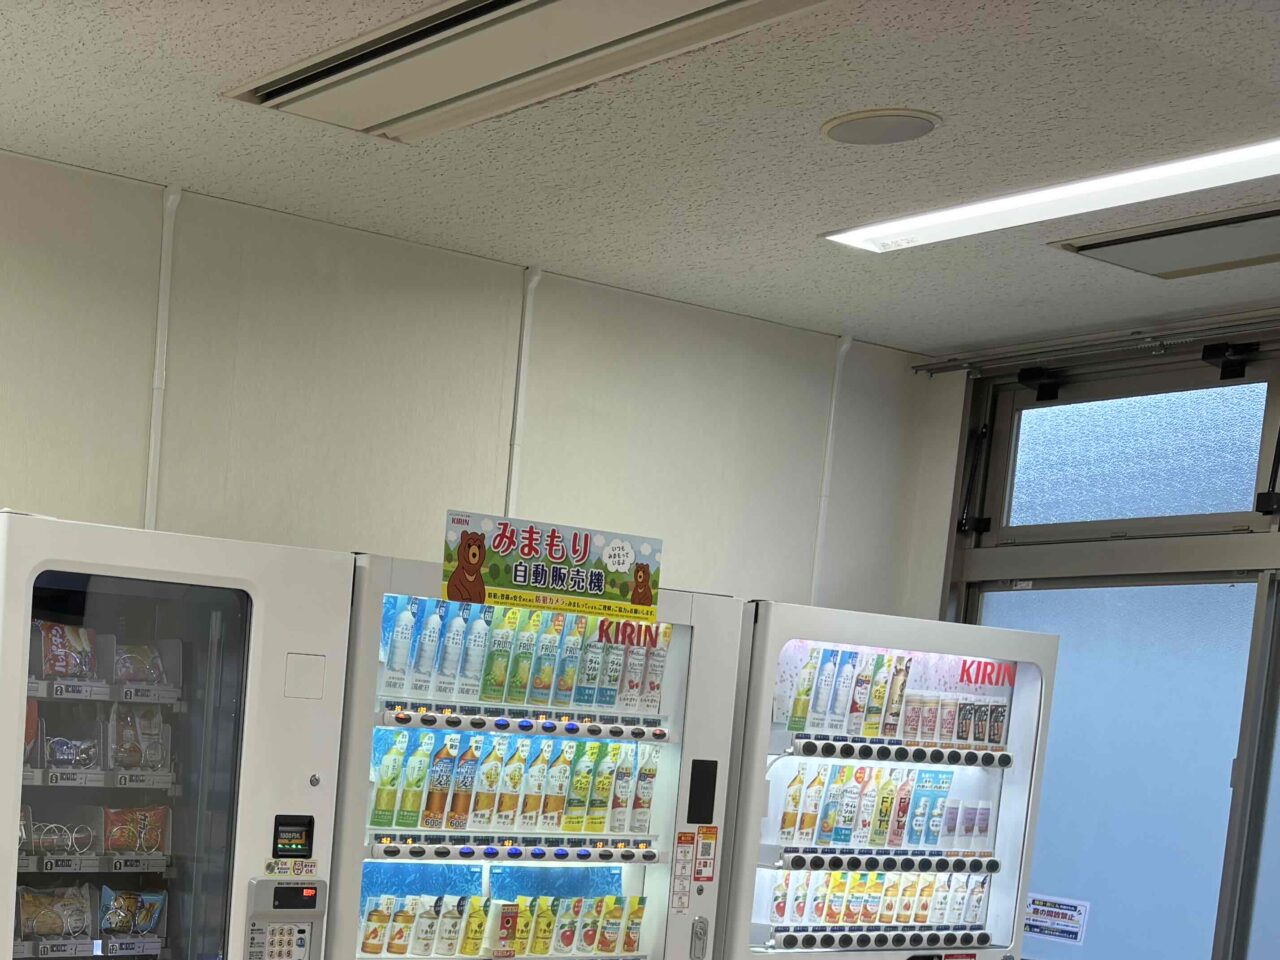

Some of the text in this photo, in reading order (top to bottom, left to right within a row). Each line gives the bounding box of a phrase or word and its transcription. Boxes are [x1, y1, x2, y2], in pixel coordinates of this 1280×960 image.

[451, 517, 470, 526] KIRIN
[492, 521, 591, 564] みまもり
[513, 562, 605, 593] 自動販売機
[598, 617, 660, 649] KIRIN
[960, 658, 1018, 688] KIRIN
